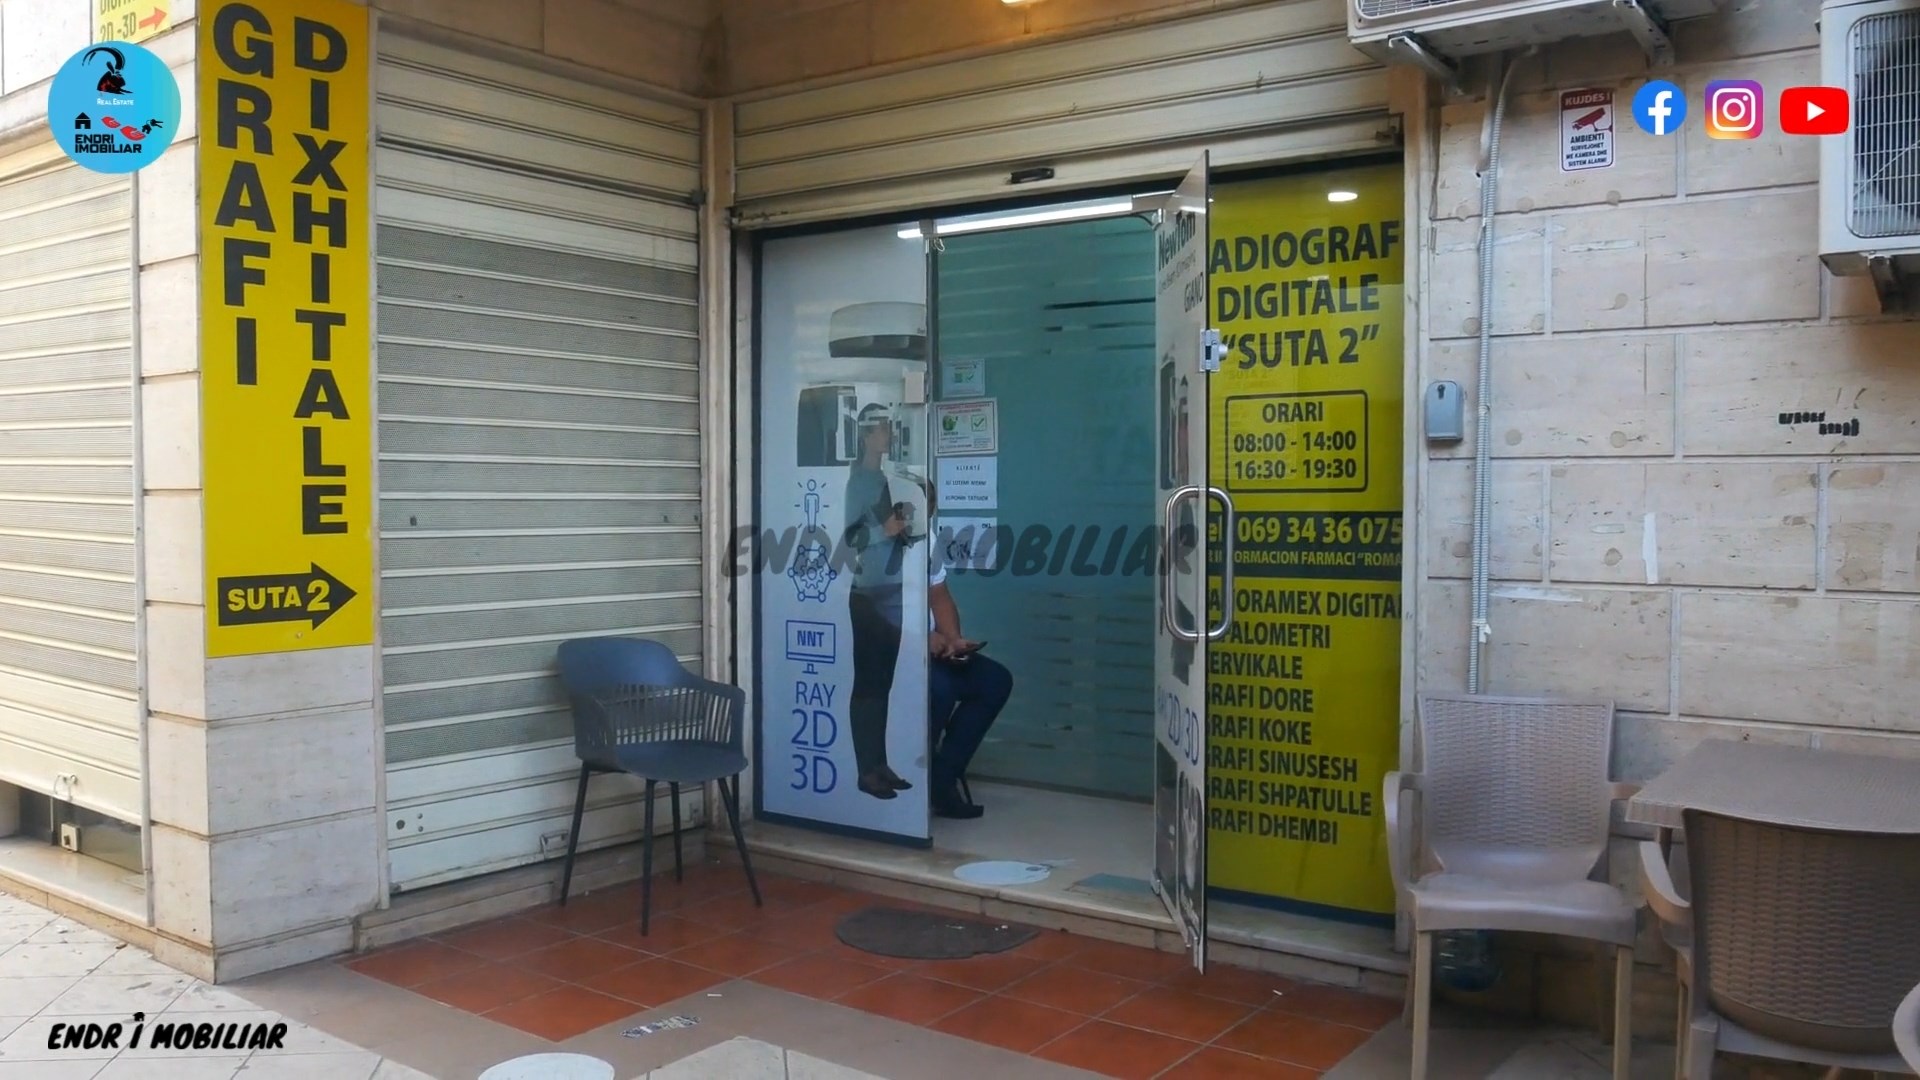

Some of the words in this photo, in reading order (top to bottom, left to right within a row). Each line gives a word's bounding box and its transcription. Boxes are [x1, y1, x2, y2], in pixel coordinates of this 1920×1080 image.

[1565, 93, 1604, 106] KUJDES
[1570, 133, 1605, 143] AMBIENTI
[213, 3, 276, 386] GRAFI
[1209, 220, 1400, 275] ADIOGRAF
[291, 16, 350, 535] DIXHITALE
[1217, 274, 1380, 322] DIGITALE
[1262, 401, 1324, 423] ORARI
[1234, 432, 1286, 453] 08:00
[1303, 430, 1357, 451] 14:00
[1235, 459, 1286, 480] 16:30
[1303, 458, 1357, 479] 19:30
[1237, 517, 1281, 543] 069
[1286, 517, 1317, 544] 34
[1322, 517, 1352, 544] 36
[1358, 517, 1402, 545] 075
[1301, 552, 1356, 566] FARMACI
[228, 586, 303, 611] SUTA
[306, 579, 331, 611] 2
[1208, 588, 1322, 615] AORAMEX
[1327, 592, 1402, 619] DIGITA
[797, 630, 825, 648] NNT
[1208, 651, 1303, 680] ERVIKALE
[795, 681, 836, 707] RAY
[1259, 686, 1314, 713] DORE
[791, 708, 837, 749] 2D
[1259, 718, 1312, 746] KOKE
[791, 754, 837, 793] 3D
[1259, 749, 1358, 782] SINUSESH
[1259, 781, 1372, 817] SHPATULLE
[1259, 812, 1338, 845] DHEMBI
